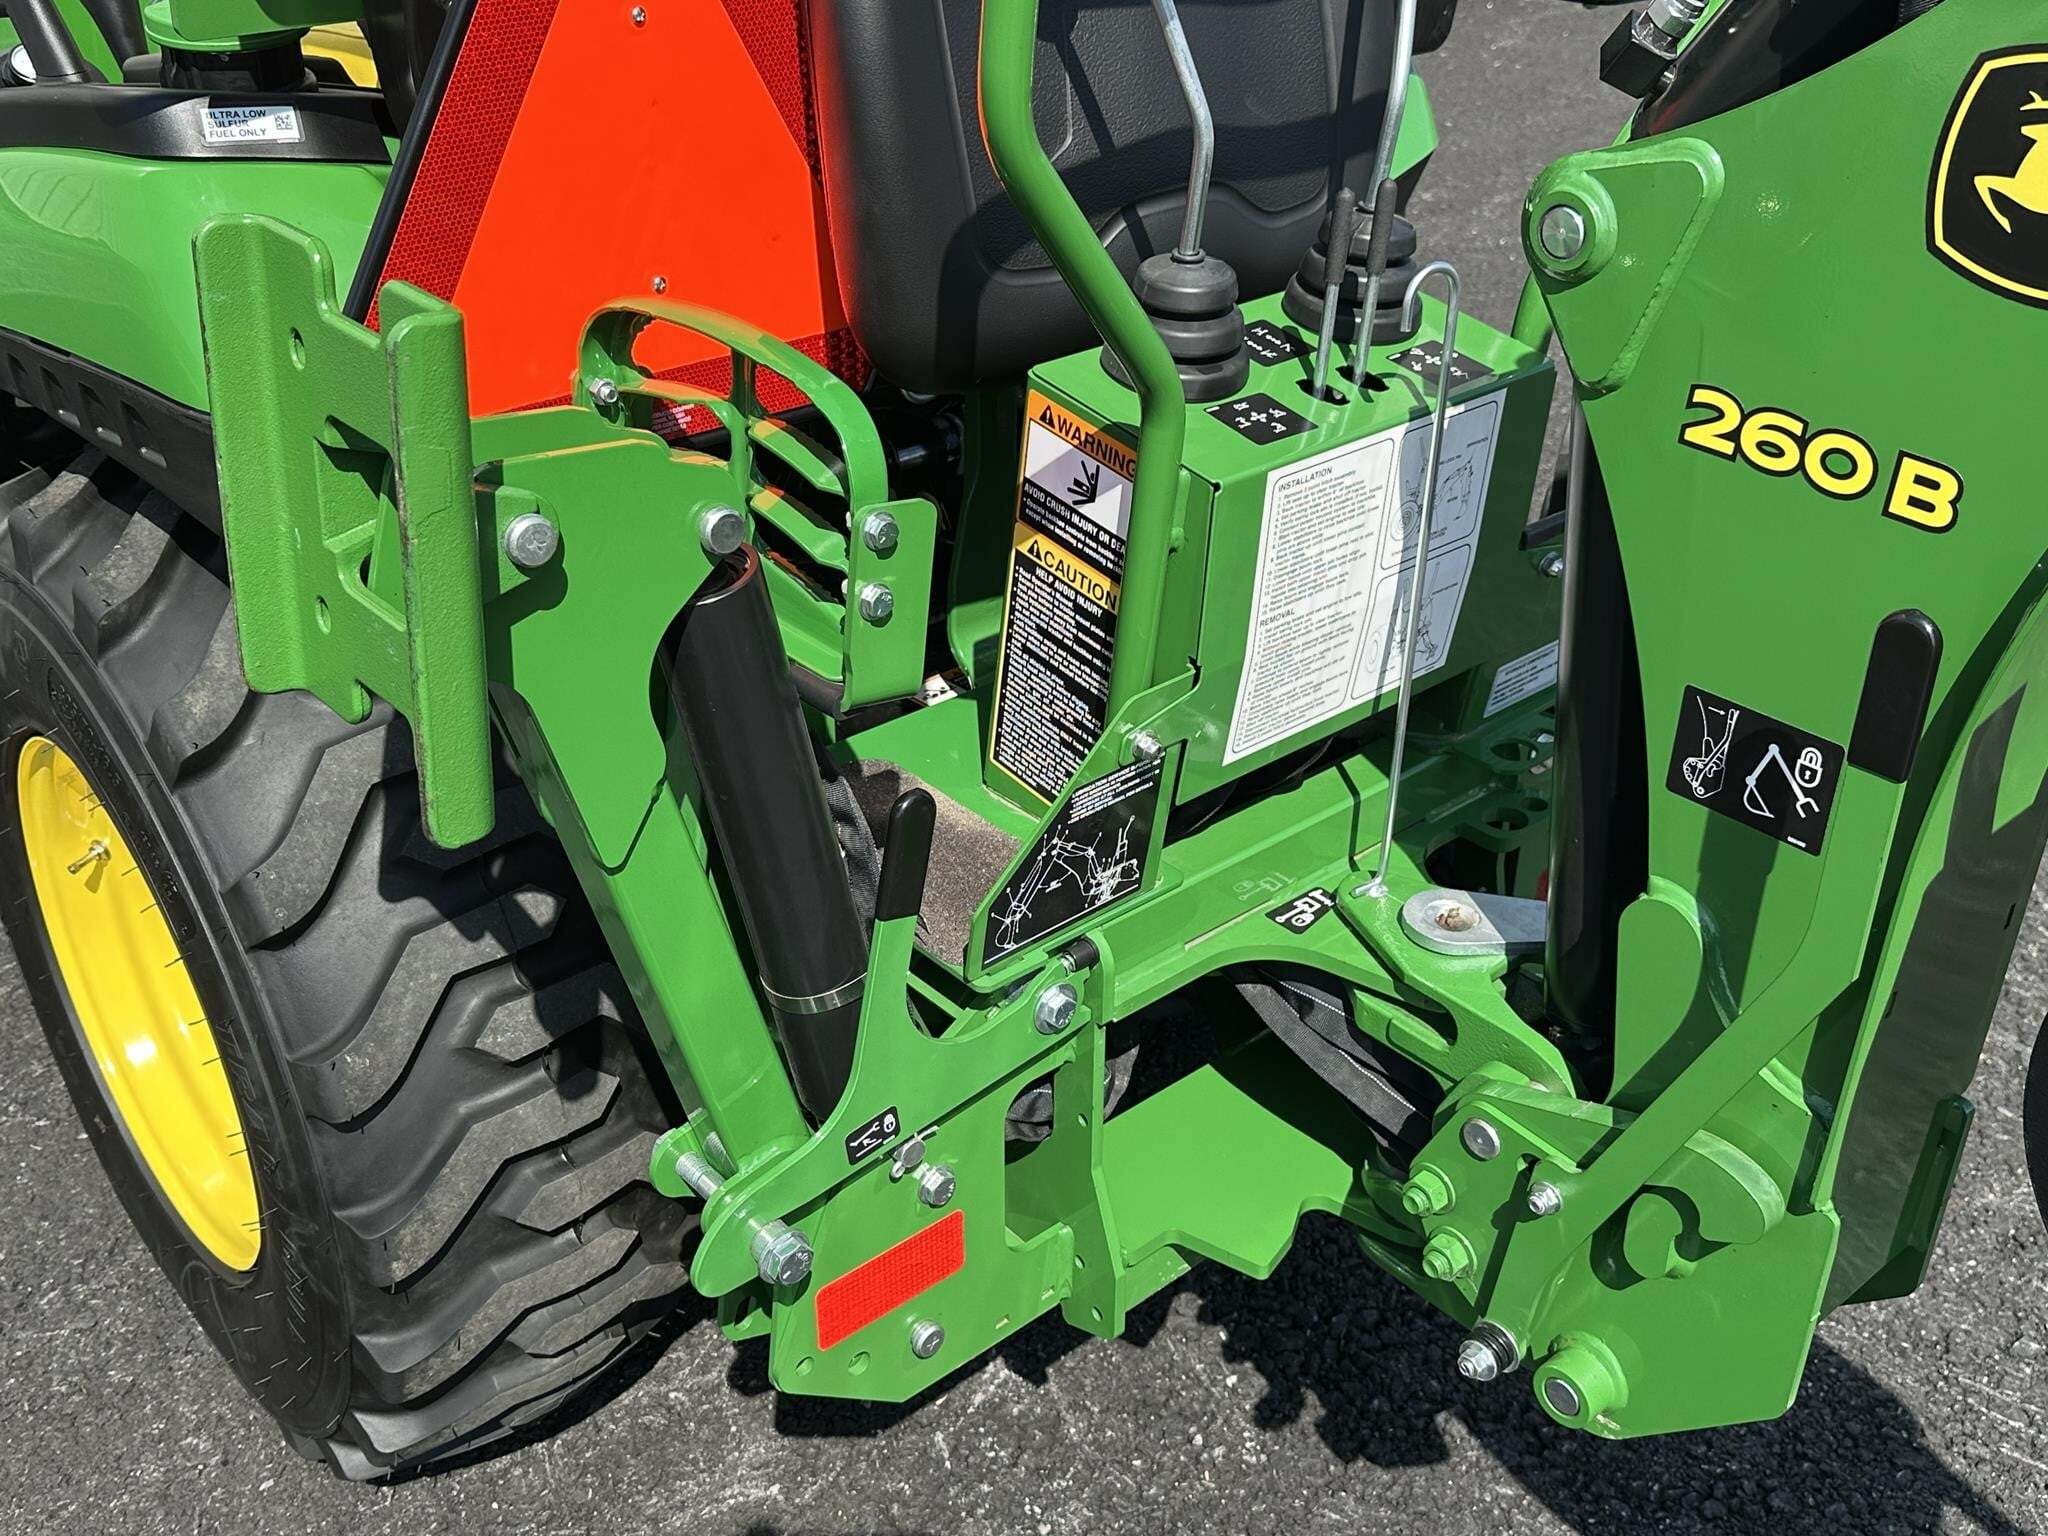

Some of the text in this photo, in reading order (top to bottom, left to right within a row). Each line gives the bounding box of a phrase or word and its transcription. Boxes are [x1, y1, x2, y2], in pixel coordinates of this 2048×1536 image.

[208, 119, 249, 129] SULFUR
[209, 127, 267, 138] FUEL ONLY
[243, 109, 267, 119] LOW
[1057, 414, 1136, 478] WARNING
[1677, 383, 1964, 534] 260 B
[1278, 467, 1333, 492] INSTALLATION
[1024, 482, 1046, 503] AVOID
[1046, 494, 1071, 519] CRUSH
[1071, 512, 1098, 536] INJURY
[1099, 532, 1110, 546] OR
[1036, 566, 1103, 618] HELP AVOID INJURY
[1044, 550, 1117, 611] CAUTION
[1259, 608, 1296, 626] REMOVAL
